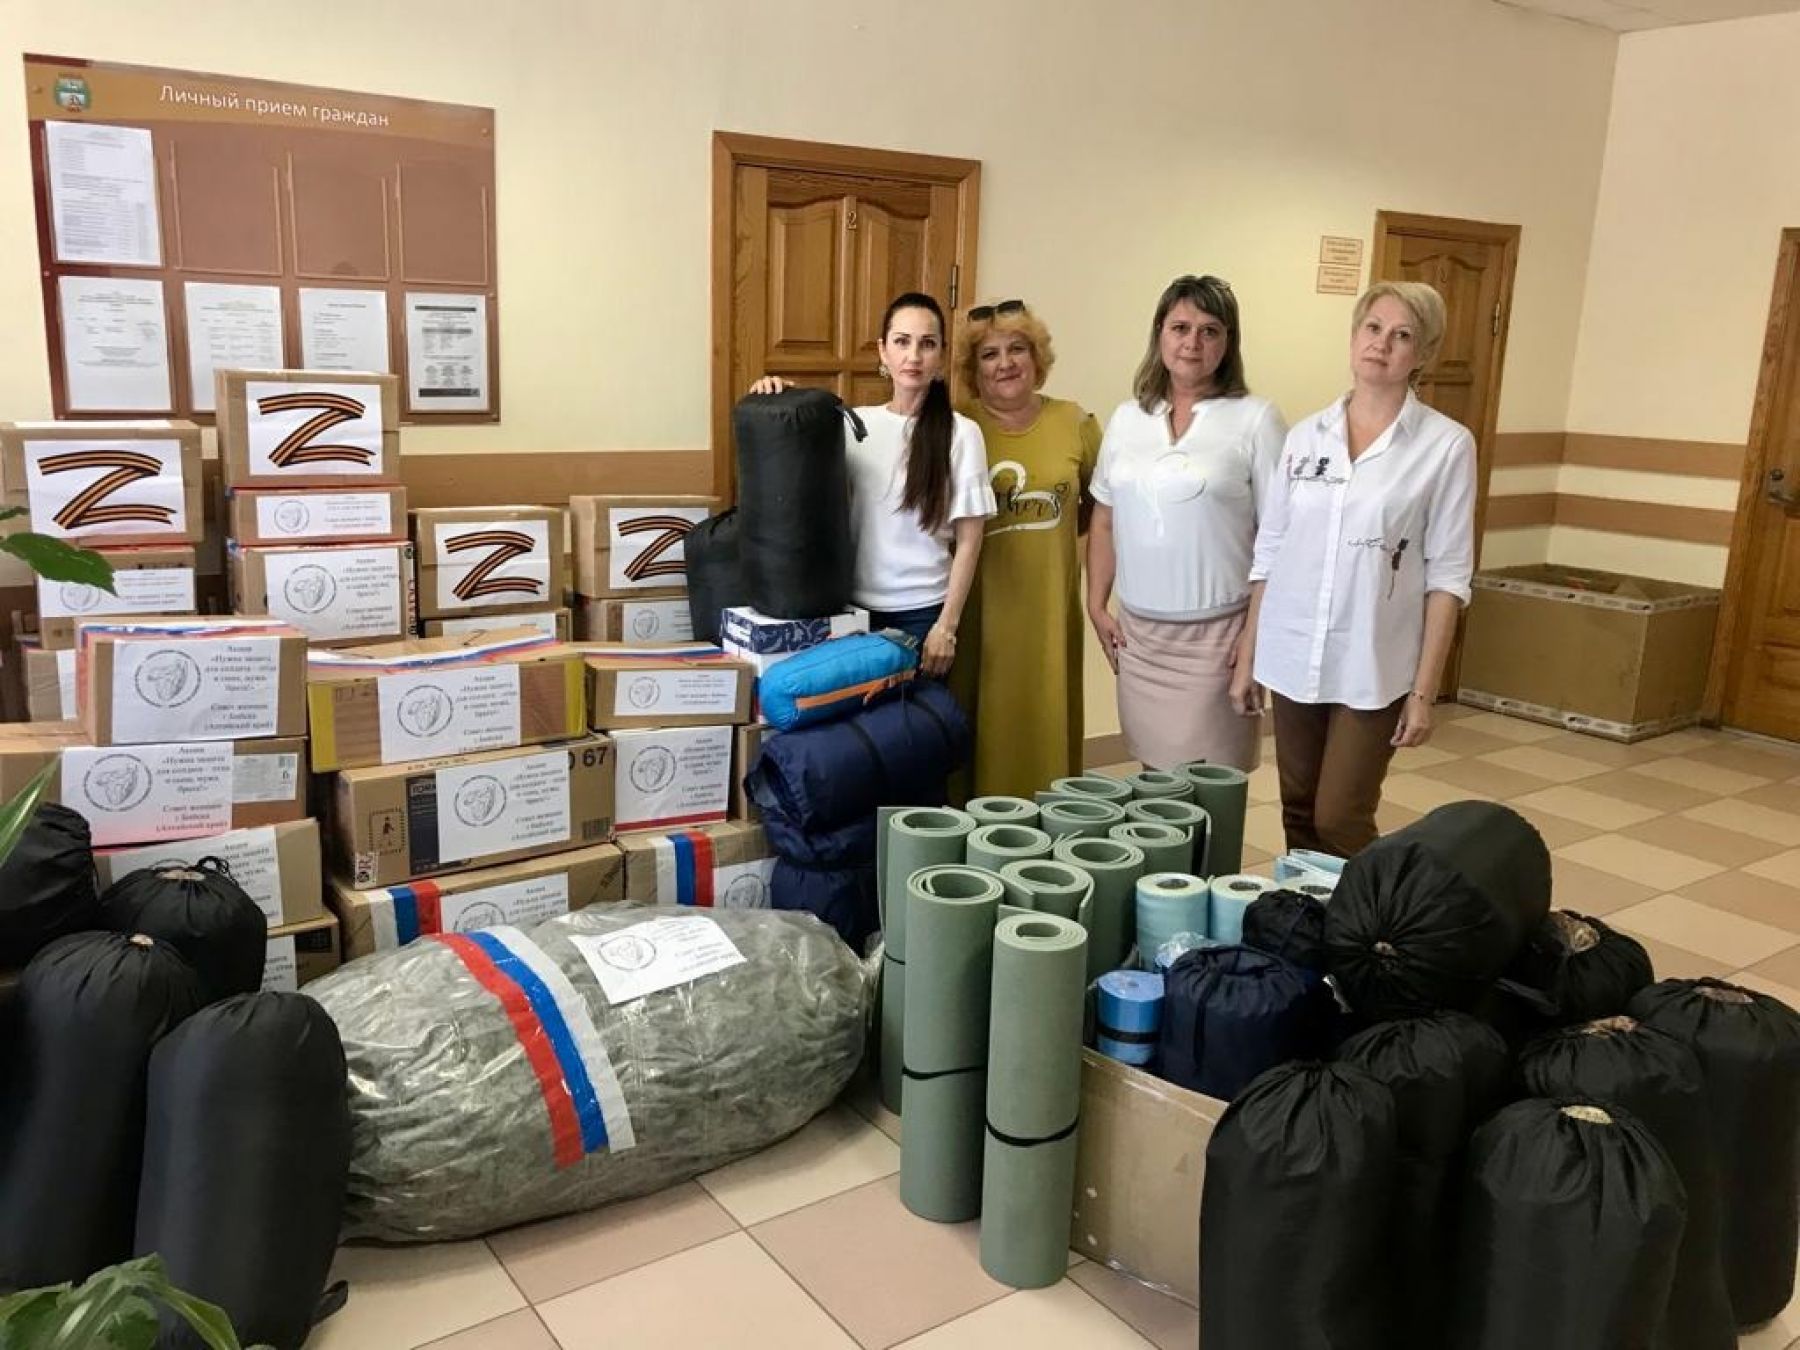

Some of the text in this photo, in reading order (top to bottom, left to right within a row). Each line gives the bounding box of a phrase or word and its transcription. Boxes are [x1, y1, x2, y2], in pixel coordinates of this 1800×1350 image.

[160, 85, 390, 127] Личный прием граждан
[256, 392, 377, 468] Z
[37, 450, 177, 529] Z
[444, 530, 544, 601] Z
[582, 746, 609, 767] 67
